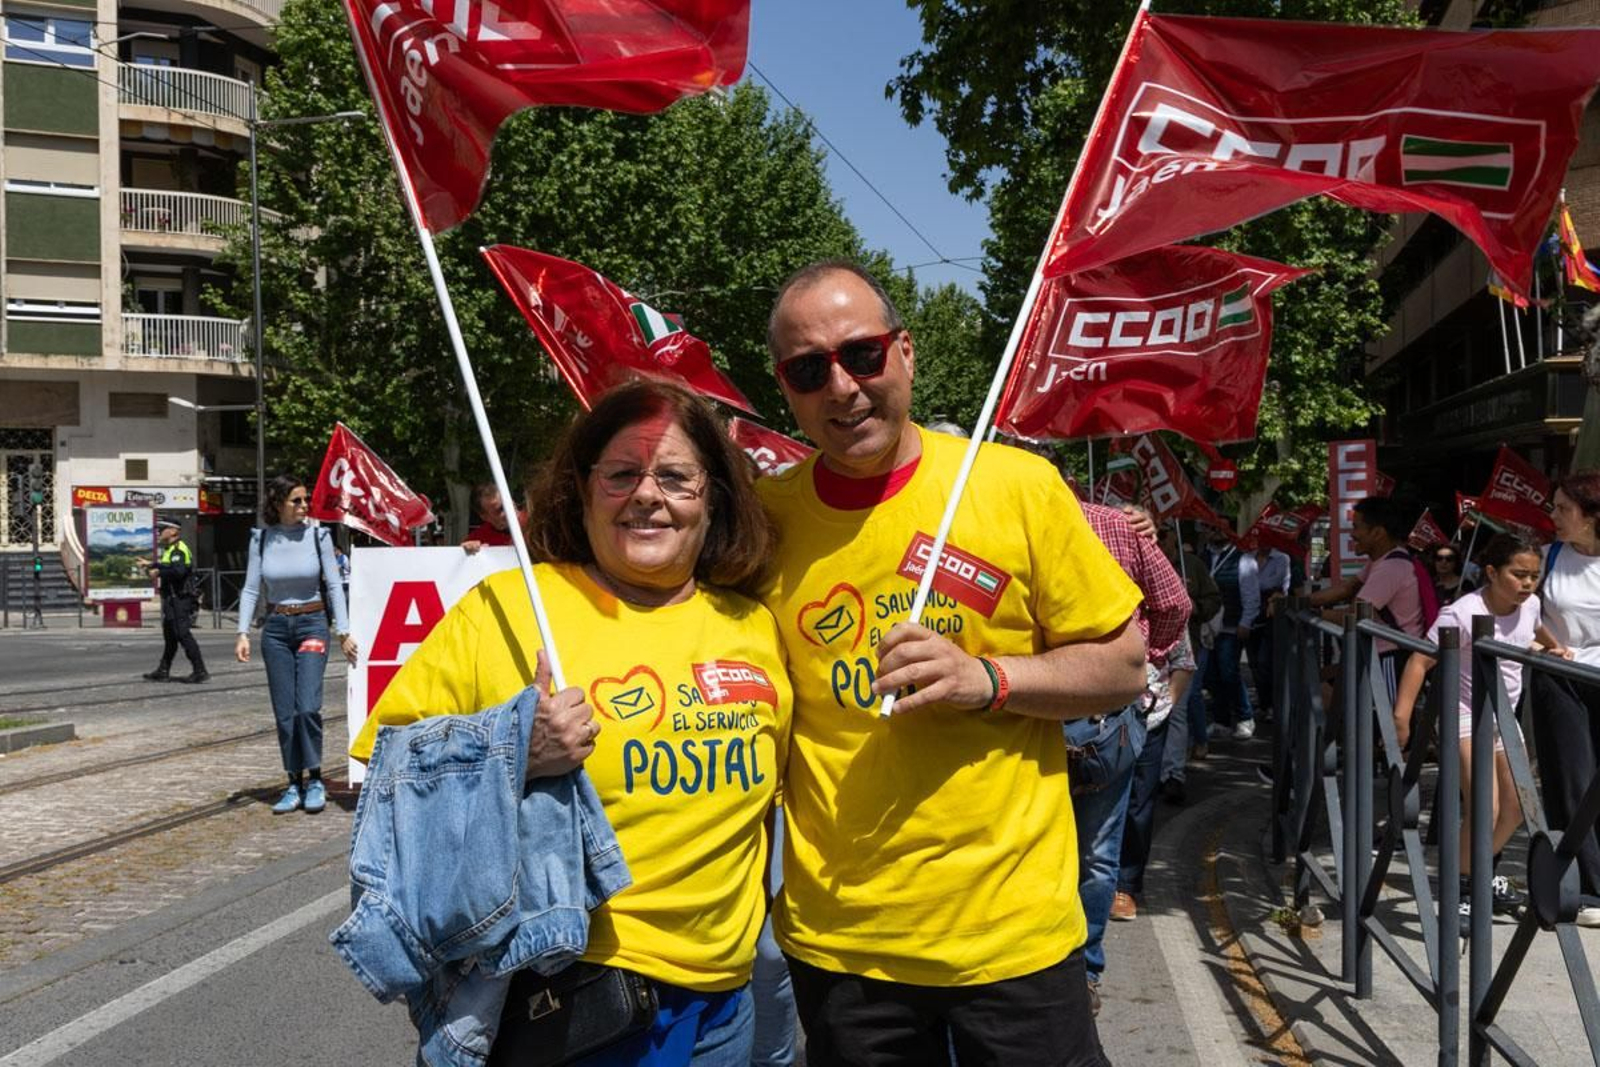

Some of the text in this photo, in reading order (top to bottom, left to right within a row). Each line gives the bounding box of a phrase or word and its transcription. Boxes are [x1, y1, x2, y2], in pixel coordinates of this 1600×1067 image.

[1068, 299, 1216, 347] CCOO
[1037, 361, 1107, 393] Jén
[77, 489, 108, 502] DELTA
[701, 668, 754, 683] CCOO
[673, 710, 759, 732] EL SERVICIO
[623, 734, 765, 796] POSTAL
